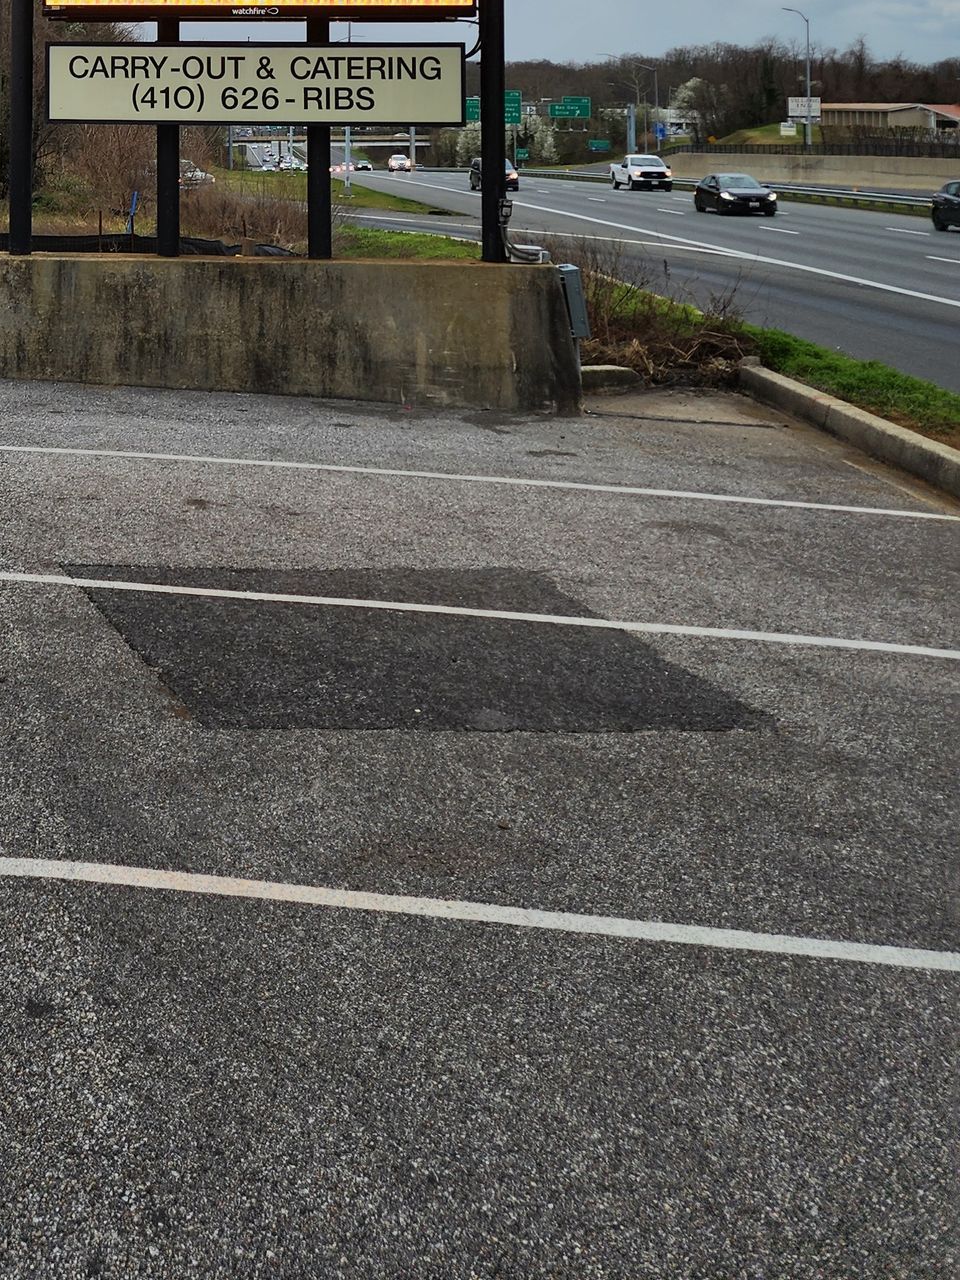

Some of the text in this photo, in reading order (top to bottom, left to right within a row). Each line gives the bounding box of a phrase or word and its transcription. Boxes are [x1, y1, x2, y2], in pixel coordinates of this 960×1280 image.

[68, 55, 442, 81] CARRY-OUT & CATERING
[131, 83, 206, 113] (410)
